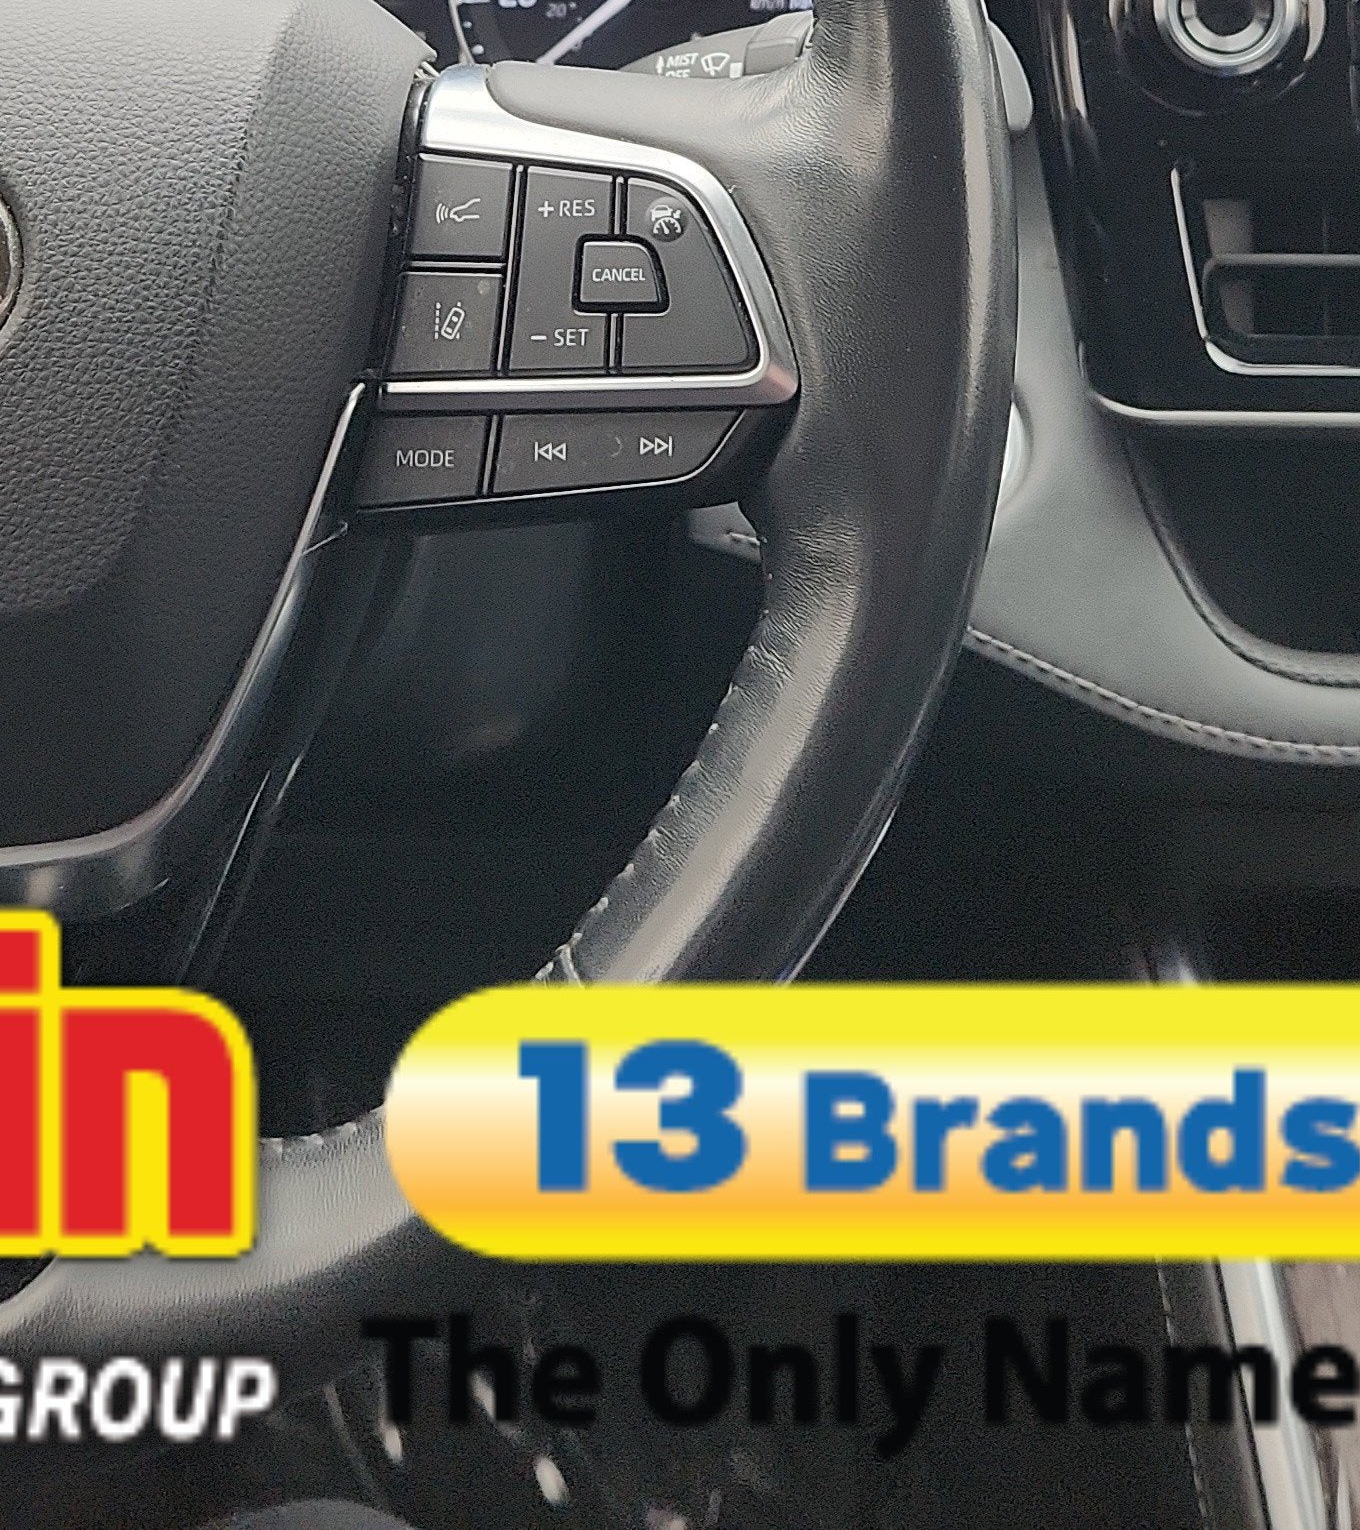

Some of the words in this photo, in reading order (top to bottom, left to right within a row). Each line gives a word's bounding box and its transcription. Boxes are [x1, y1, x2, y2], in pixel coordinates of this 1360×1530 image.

[545, 2, 568, 19] 20
[666, 52, 699, 69] MIST
[592, 267, 646, 283] CANCEL
[396, 449, 455, 468] MODE
